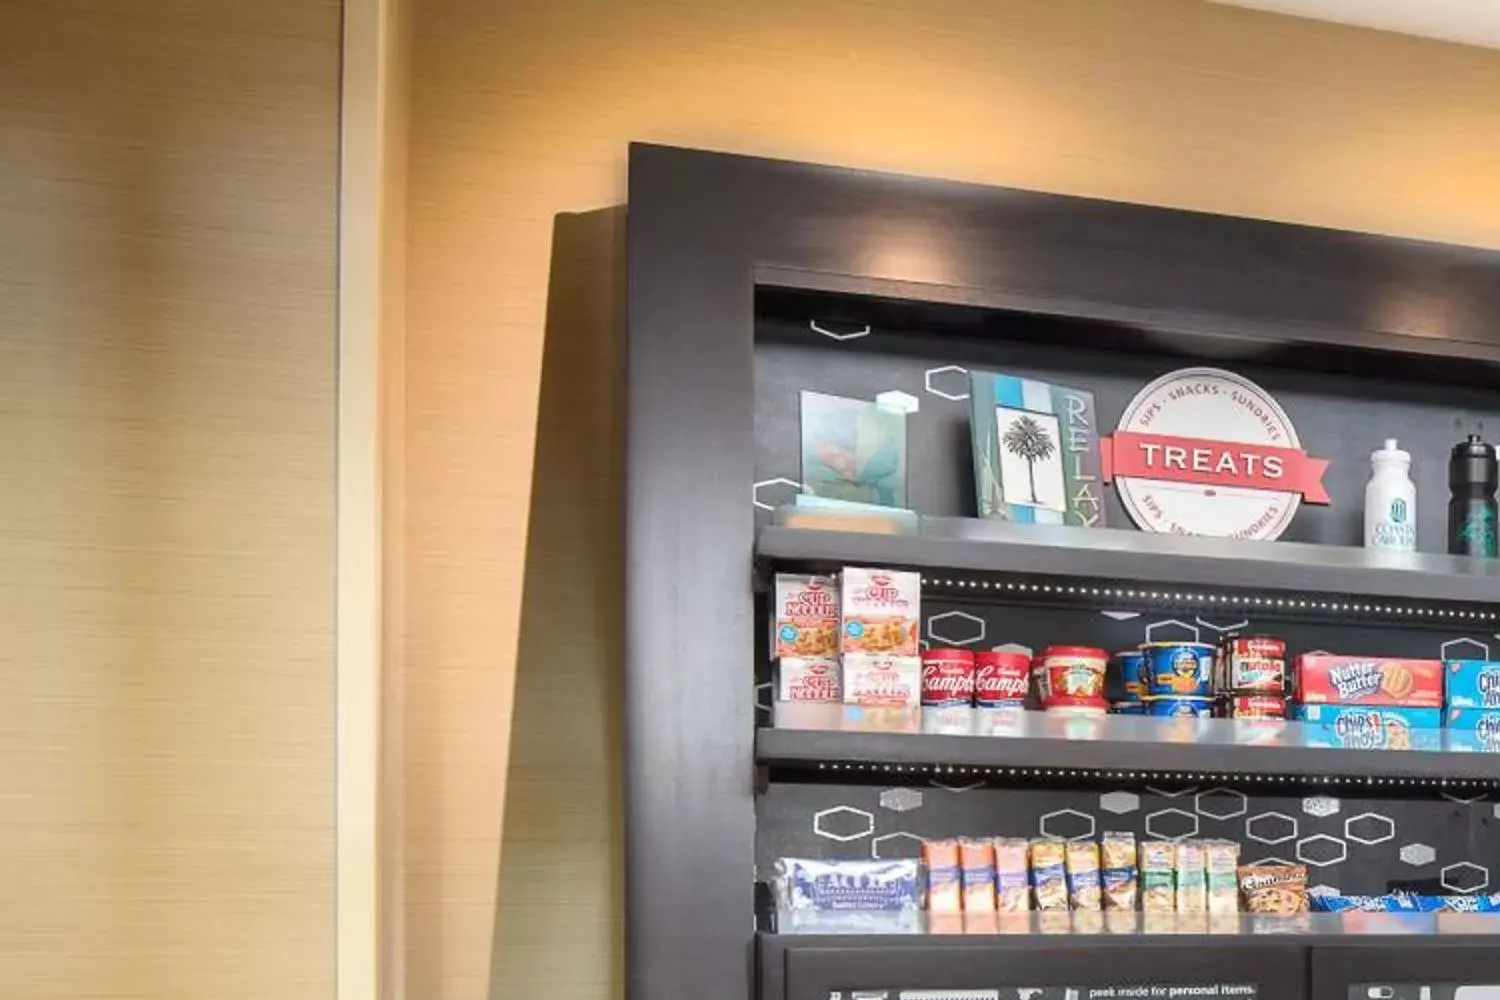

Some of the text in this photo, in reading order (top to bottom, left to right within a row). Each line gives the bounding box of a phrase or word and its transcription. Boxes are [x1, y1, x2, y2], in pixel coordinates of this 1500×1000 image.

[1140, 383, 1281, 440] SIPS SNACKS SUNDRIES
[1139, 443, 1284, 478] TREATS
[1142, 495, 1161, 520] SIPS
[1329, 662, 1376, 685] Nutter
[1338, 673, 1382, 698] Butter
[1151, 985, 1167, 996] for
[1169, 984, 1218, 998] personal
